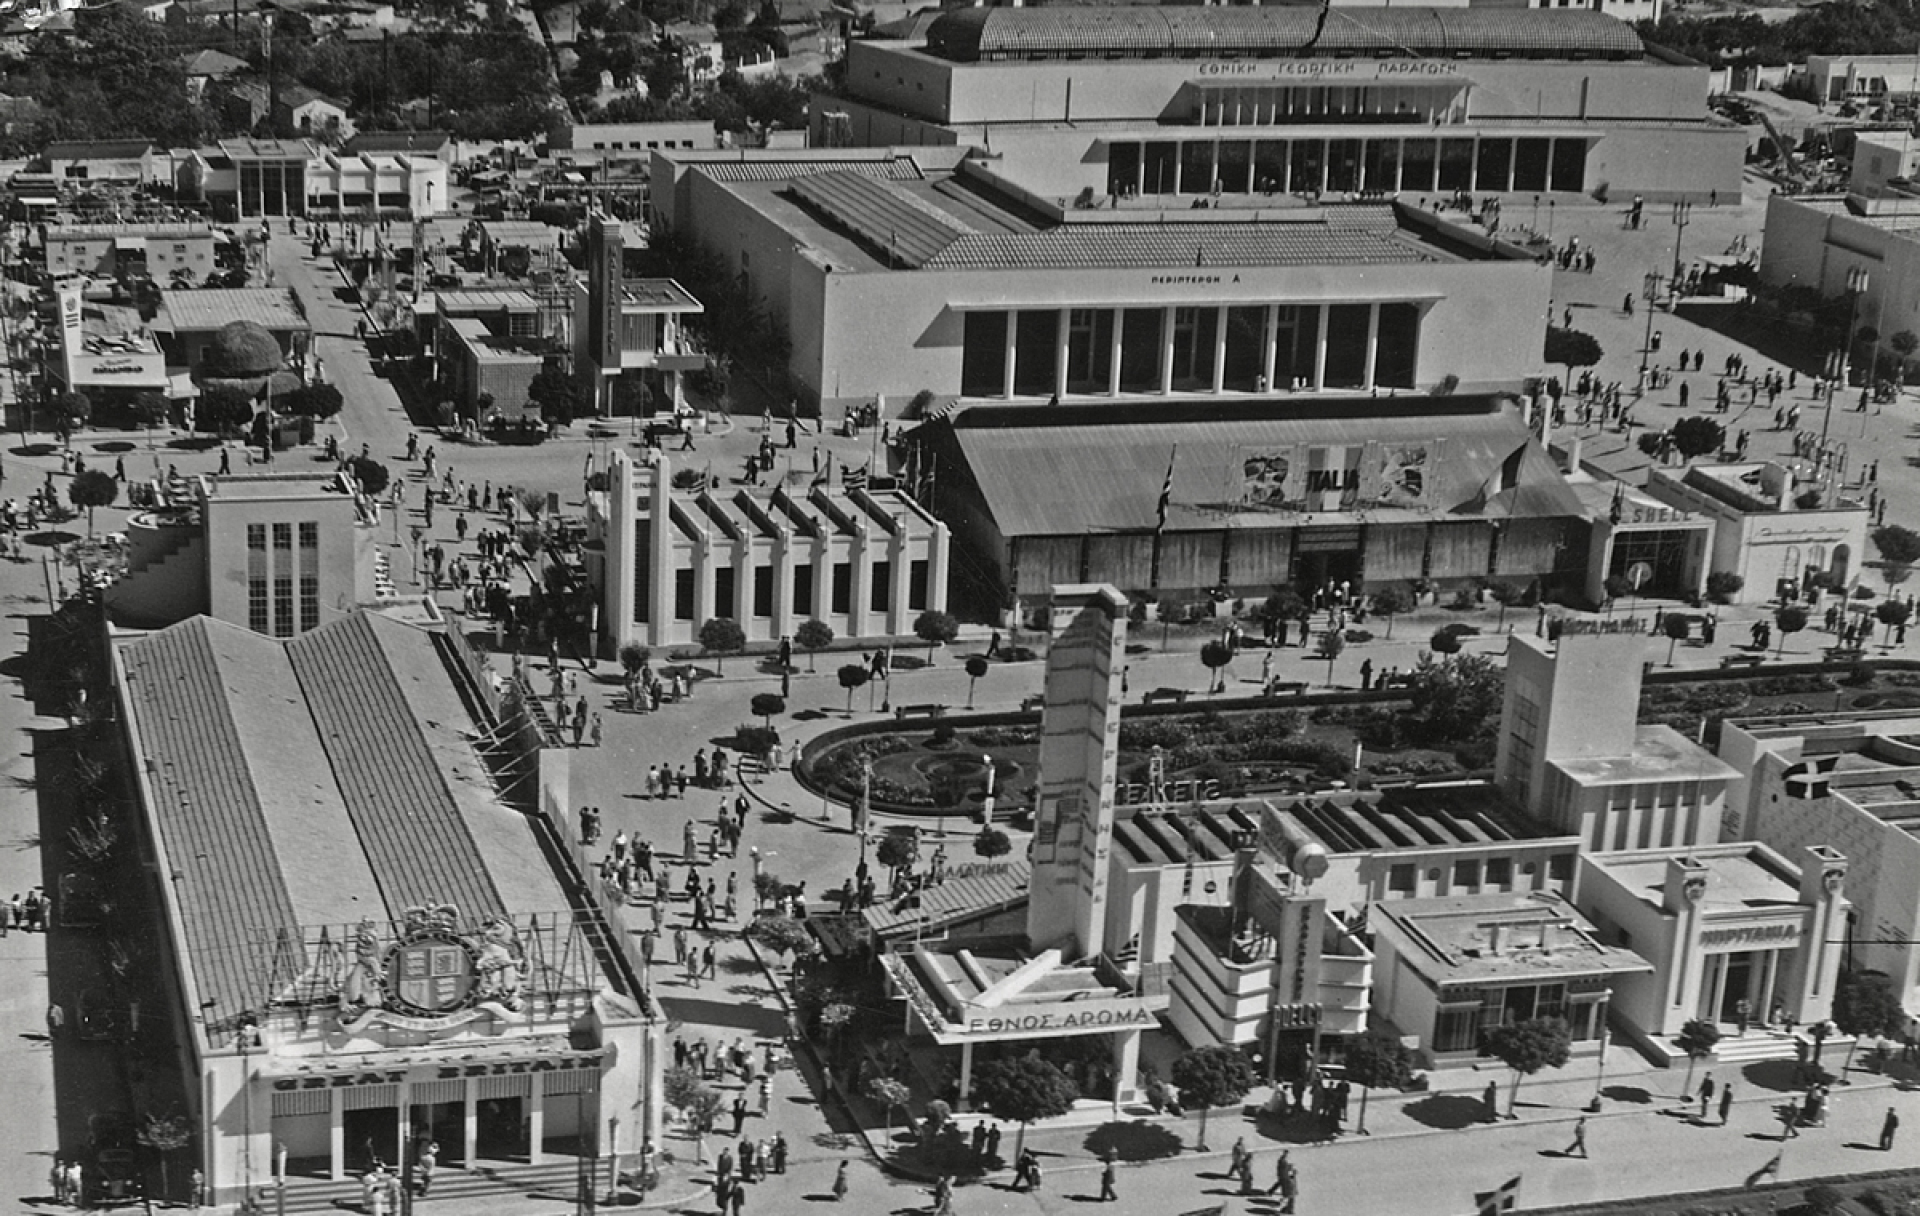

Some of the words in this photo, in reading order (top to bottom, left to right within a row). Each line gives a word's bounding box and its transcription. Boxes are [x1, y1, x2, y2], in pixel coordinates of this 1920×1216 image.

[1198, 62, 1257, 75] ΕΘΝΙΚΗ
[1277, 62, 1355, 75] ΓΕΩΡΓΙΚΗ
[1378, 62, 1458, 75] ΠΑΡΑΓΩΓΗ
[1232, 274, 1240, 284] Α
[1306, 469, 1360, 492] ITALIA
[1632, 507, 1692, 523] SHELL
[1063, 1007, 1151, 1027] ΑΡΩΜΑ
[273, 1069, 407, 1091] GREAT
[437, 1055, 604, 1079] BRITAIN
